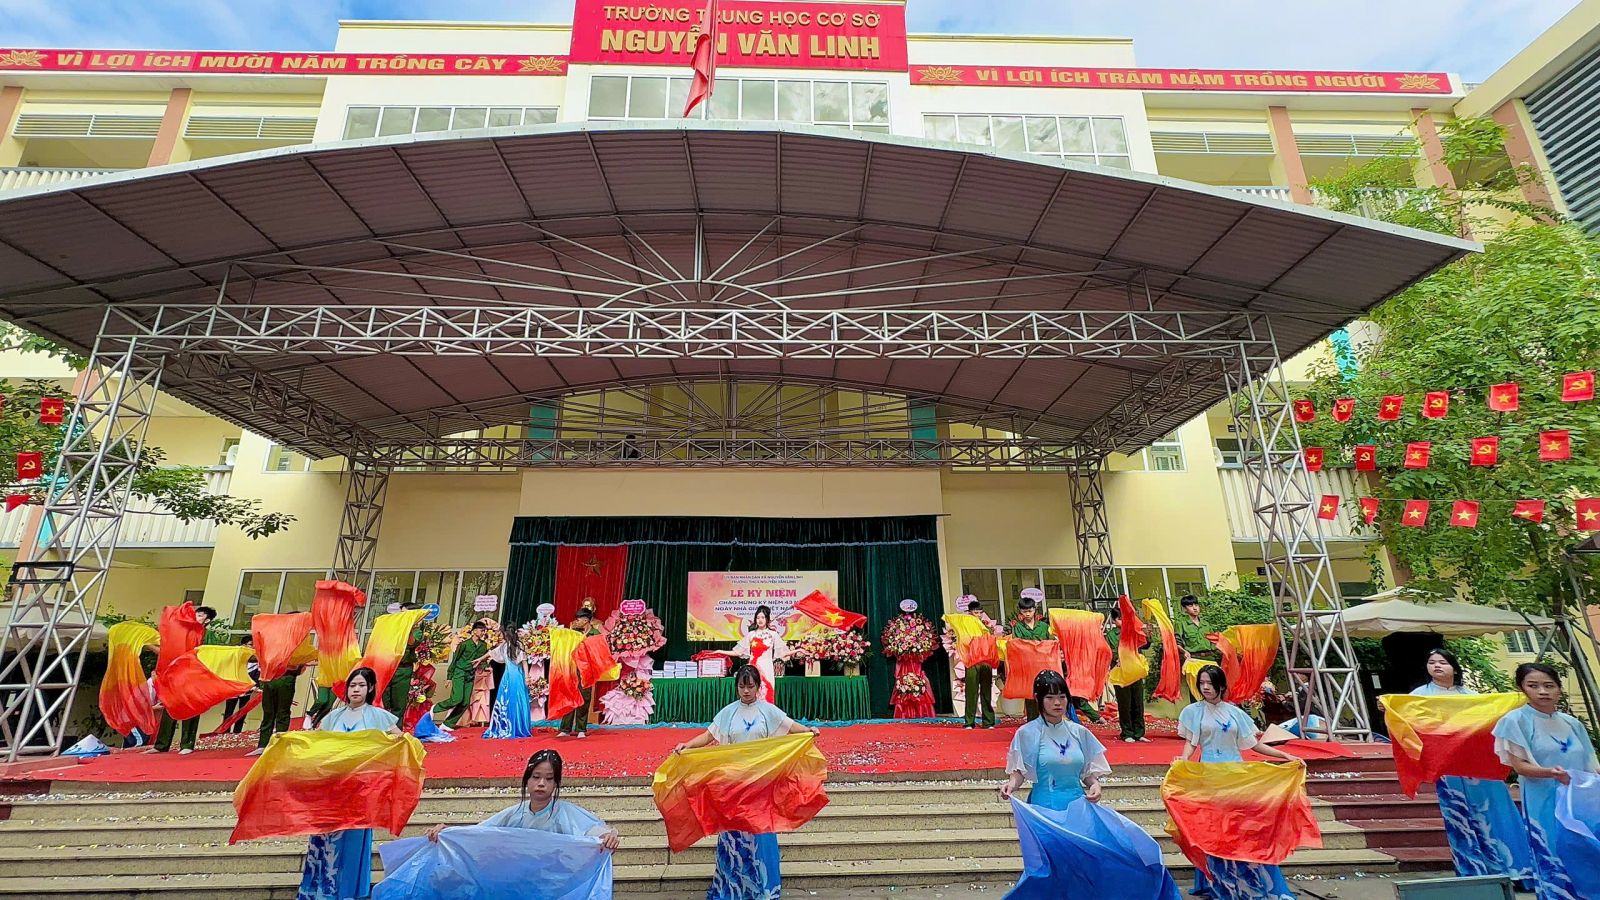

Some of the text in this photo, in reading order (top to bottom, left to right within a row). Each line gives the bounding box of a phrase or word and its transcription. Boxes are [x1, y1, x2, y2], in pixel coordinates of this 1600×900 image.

[604, 4, 880, 29] TRƯỜNG TUNG HỌC CƠ SỞ
[737, 29, 799, 56] VĂN
[810, 34, 879, 58] LINH
[57, 51, 508, 70] VÌ LỢI ÍCH MƯỜI NĂM TRỒNG CÂY
[975, 68, 1386, 88] VÌ LỢI ÍCH TRĂM NĂM TRỒNG NGƯỜI
[766, 588, 797, 599] NIỆM
